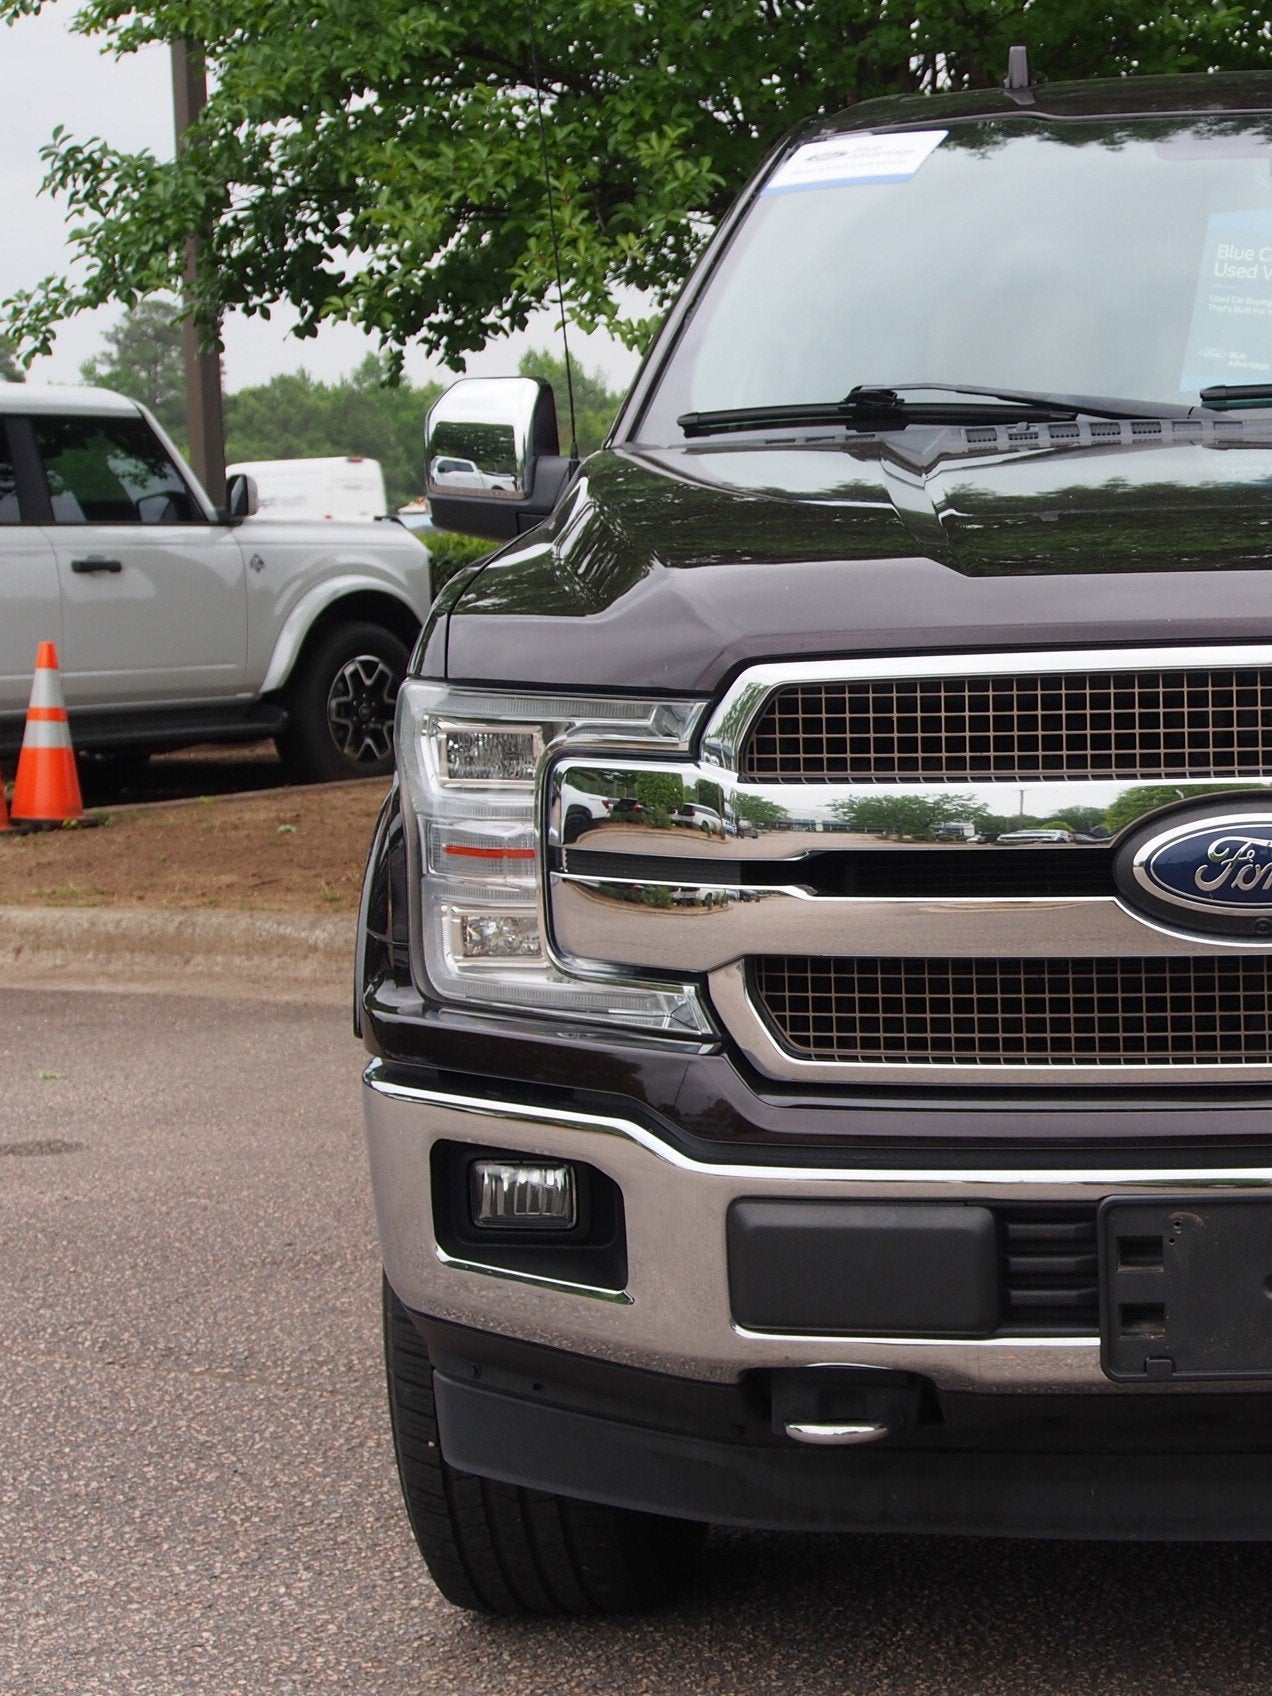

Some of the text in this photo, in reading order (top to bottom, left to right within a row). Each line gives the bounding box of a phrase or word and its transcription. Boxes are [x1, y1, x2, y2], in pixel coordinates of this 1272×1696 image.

[1216, 243, 1255, 261] Blue
[1214, 262, 1259, 279] Used
[1209, 293, 1230, 303] Used
[1231, 295, 1246, 304] Car
